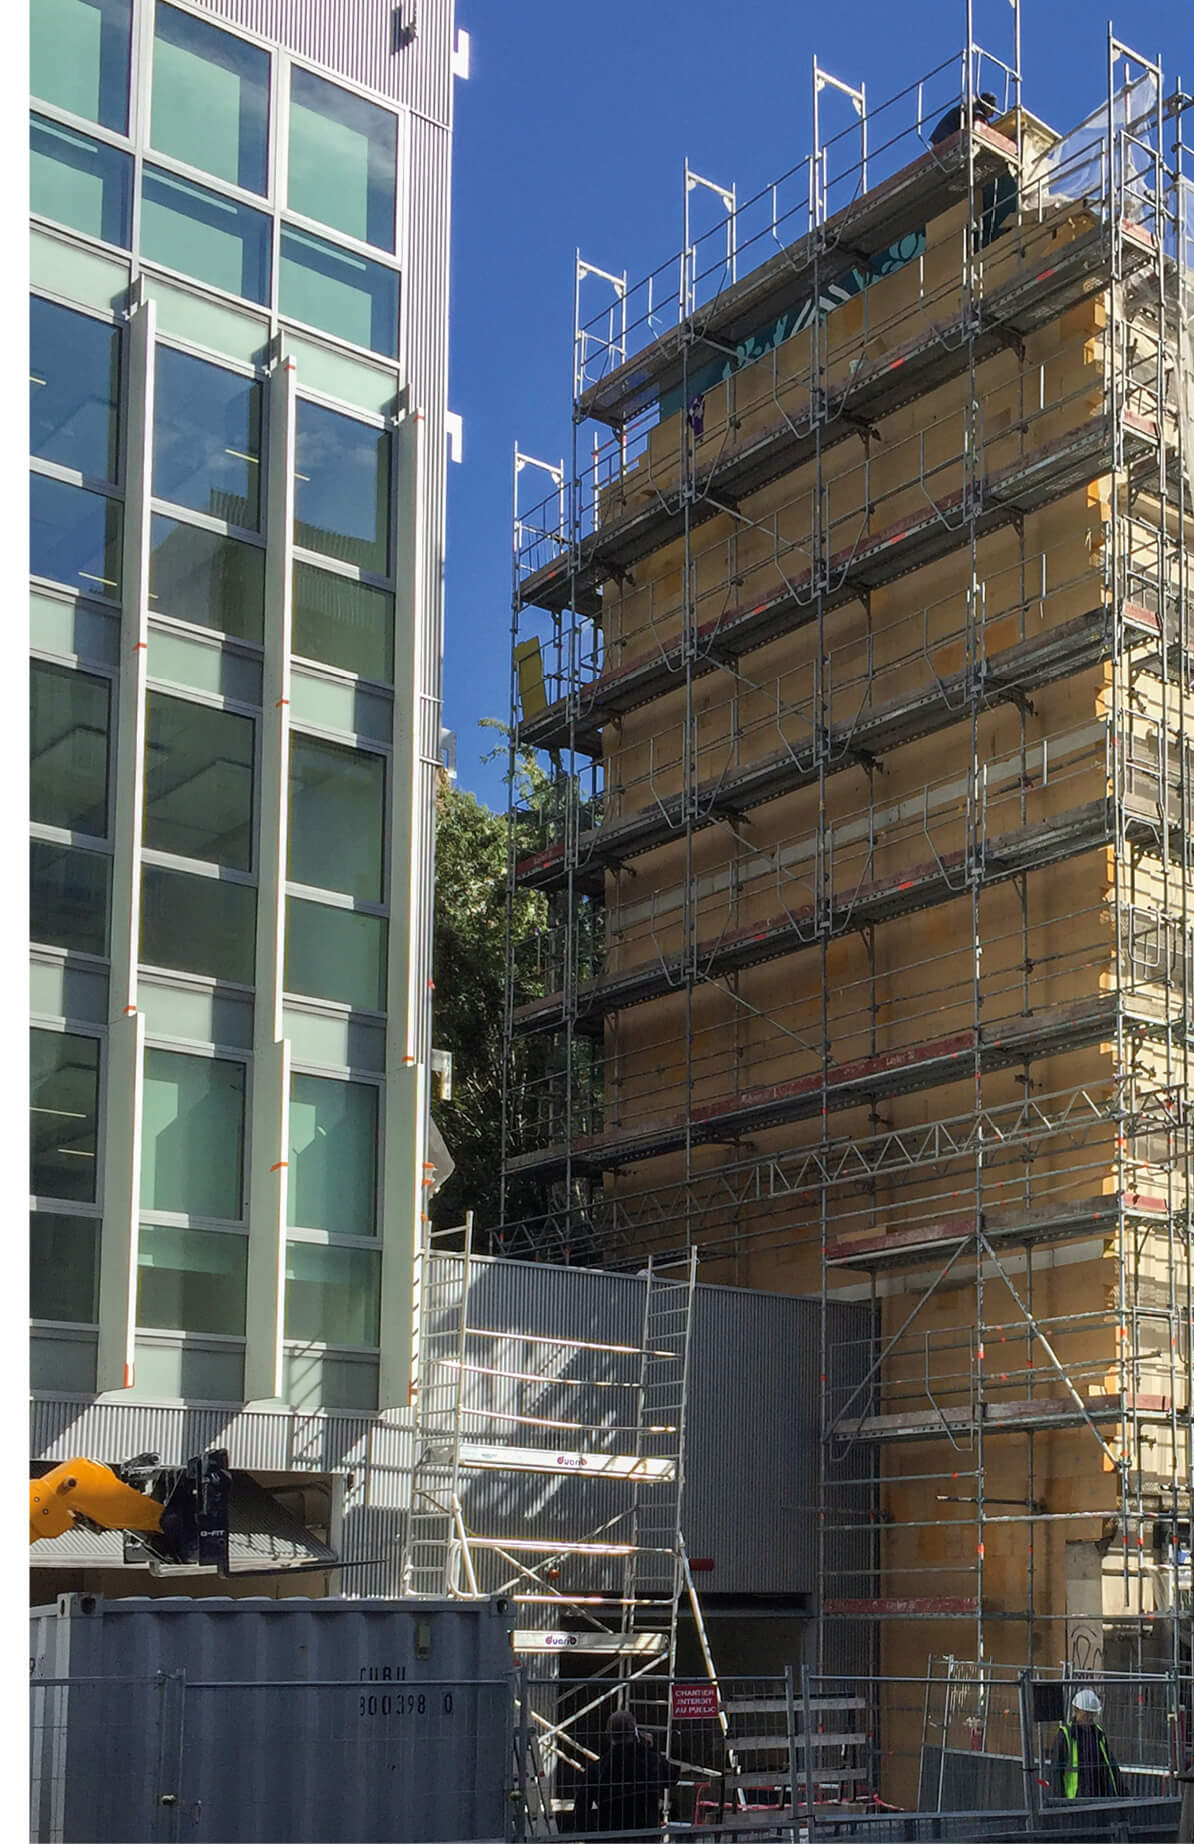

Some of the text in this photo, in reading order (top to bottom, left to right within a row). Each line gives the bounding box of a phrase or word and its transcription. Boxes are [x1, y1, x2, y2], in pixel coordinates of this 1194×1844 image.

[675, 1689, 715, 1697] CHANTIER
[677, 1697, 713, 1705] INTERDIT
[675, 1706, 687, 1714] AU
